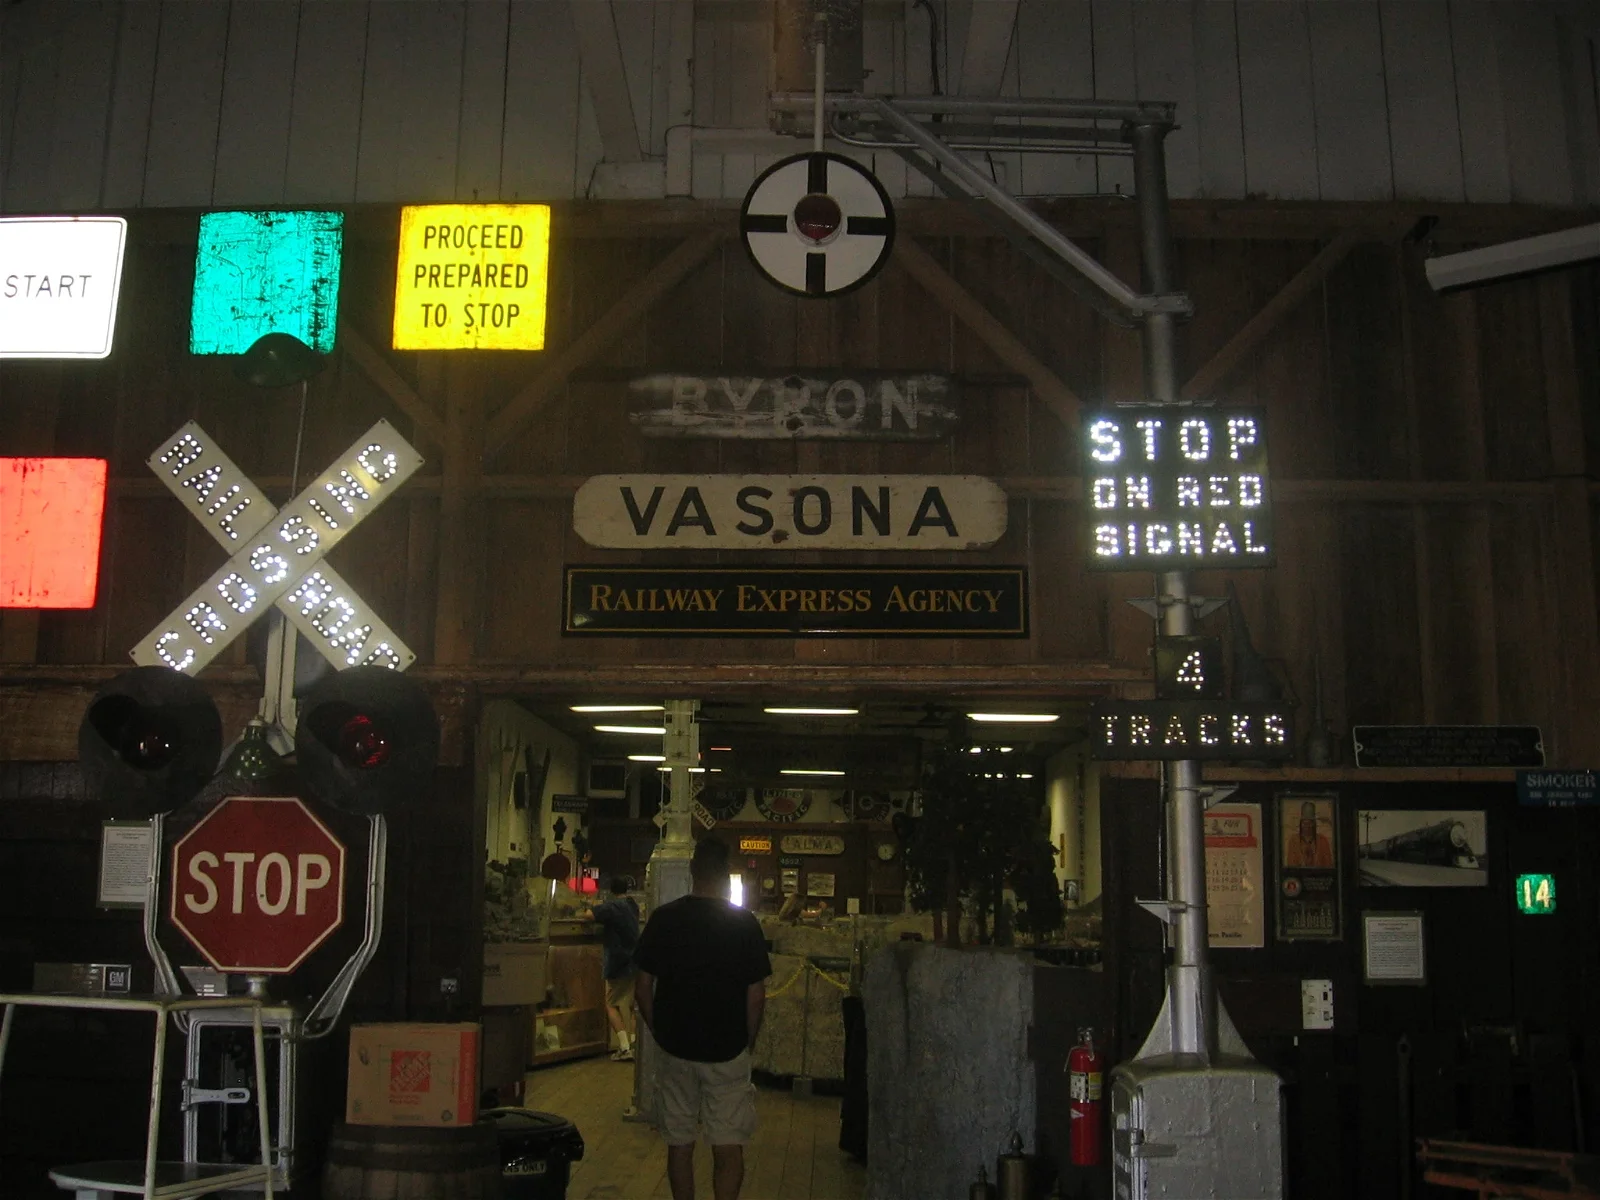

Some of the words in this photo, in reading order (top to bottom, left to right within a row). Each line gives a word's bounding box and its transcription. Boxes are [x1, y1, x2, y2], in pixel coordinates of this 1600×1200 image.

[424, 225, 523, 249] PROCEED
[3, 273, 92, 299] START
[414, 264, 528, 289] PREPARED
[421, 304, 448, 328] TO
[463, 303, 520, 328] STOP
[671, 375, 920, 430] BYRON
[1090, 419, 1257, 462] STOP
[159, 433, 252, 541] RAIL
[1092, 476, 1151, 509] ON
[1177, 475, 1262, 507] RED
[619, 485, 960, 537] VASONA
[1094, 522, 1266, 556] SIGNAL
[154, 441, 399, 670] CROSSING
[589, 583, 725, 612] RAILWAY
[735, 584, 872, 612] EXPRESS
[883, 584, 1005, 613] AGENCY
[1175, 649, 1205, 691] 4
[1099, 714, 1286, 746] TRACKS
[1526, 774, 1597, 788] SMOKER
[741, 841, 770, 849] CAUTION
[793, 837, 833, 850] ALMA
[184, 850, 332, 917] STOP
[1523, 878, 1556, 908] 14
[109, 971, 125, 984] GM
